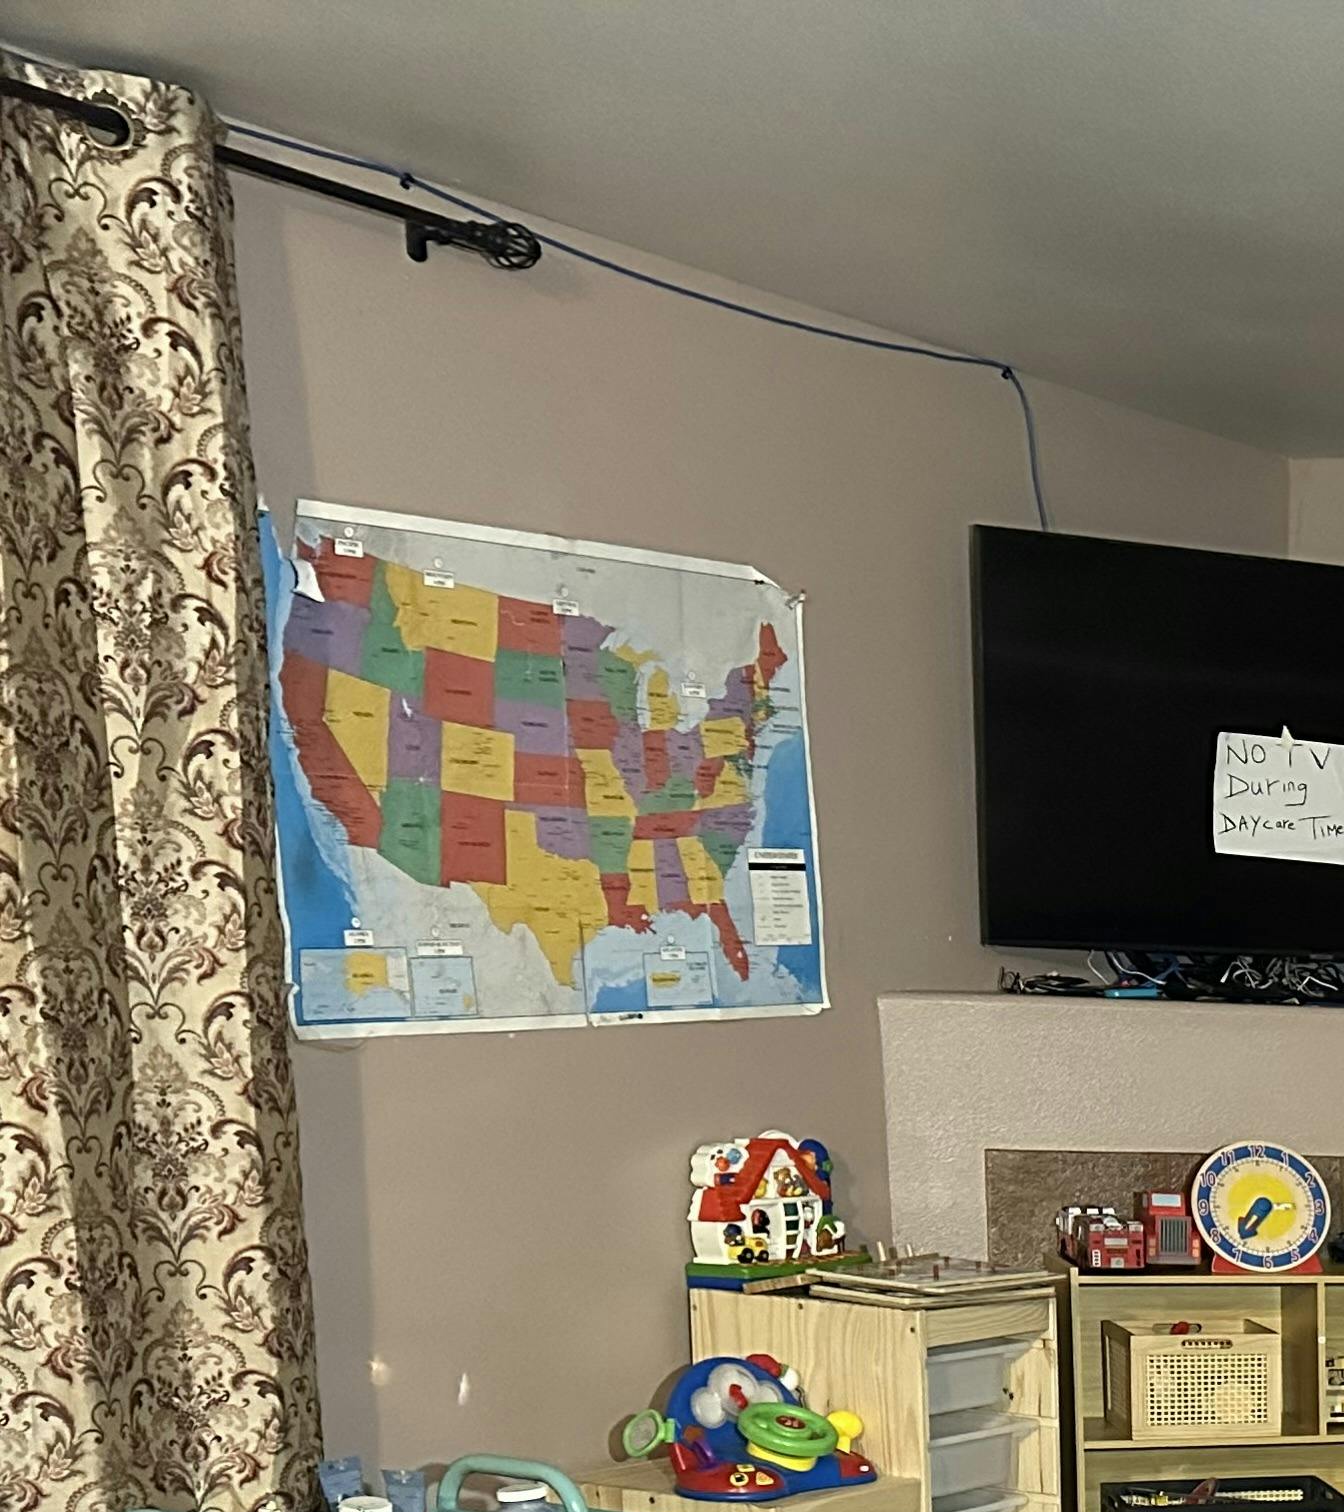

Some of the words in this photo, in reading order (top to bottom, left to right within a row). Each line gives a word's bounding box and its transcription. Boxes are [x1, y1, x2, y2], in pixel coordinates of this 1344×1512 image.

[1227, 739, 1266, 765] NO
[1275, 740, 1331, 769] TV
[1225, 773, 1307, 806] During
[1248, 1144, 1266, 1158] 12
[1221, 1152, 1235, 1166] 11
[1282, 1152, 1290, 1166] 1
[1200, 1172, 1217, 1187] 10
[1306, 1174, 1316, 1188] 2
[1198, 1201, 1208, 1216] 9
[1314, 1200, 1324, 1214] 3
[1210, 1230, 1220, 1243] 8
[1308, 1231, 1318, 1244] 4
[1232, 1248, 1242, 1262] 7
[1291, 1249, 1301, 1262] 5
[1263, 1255, 1274, 1270] 6
